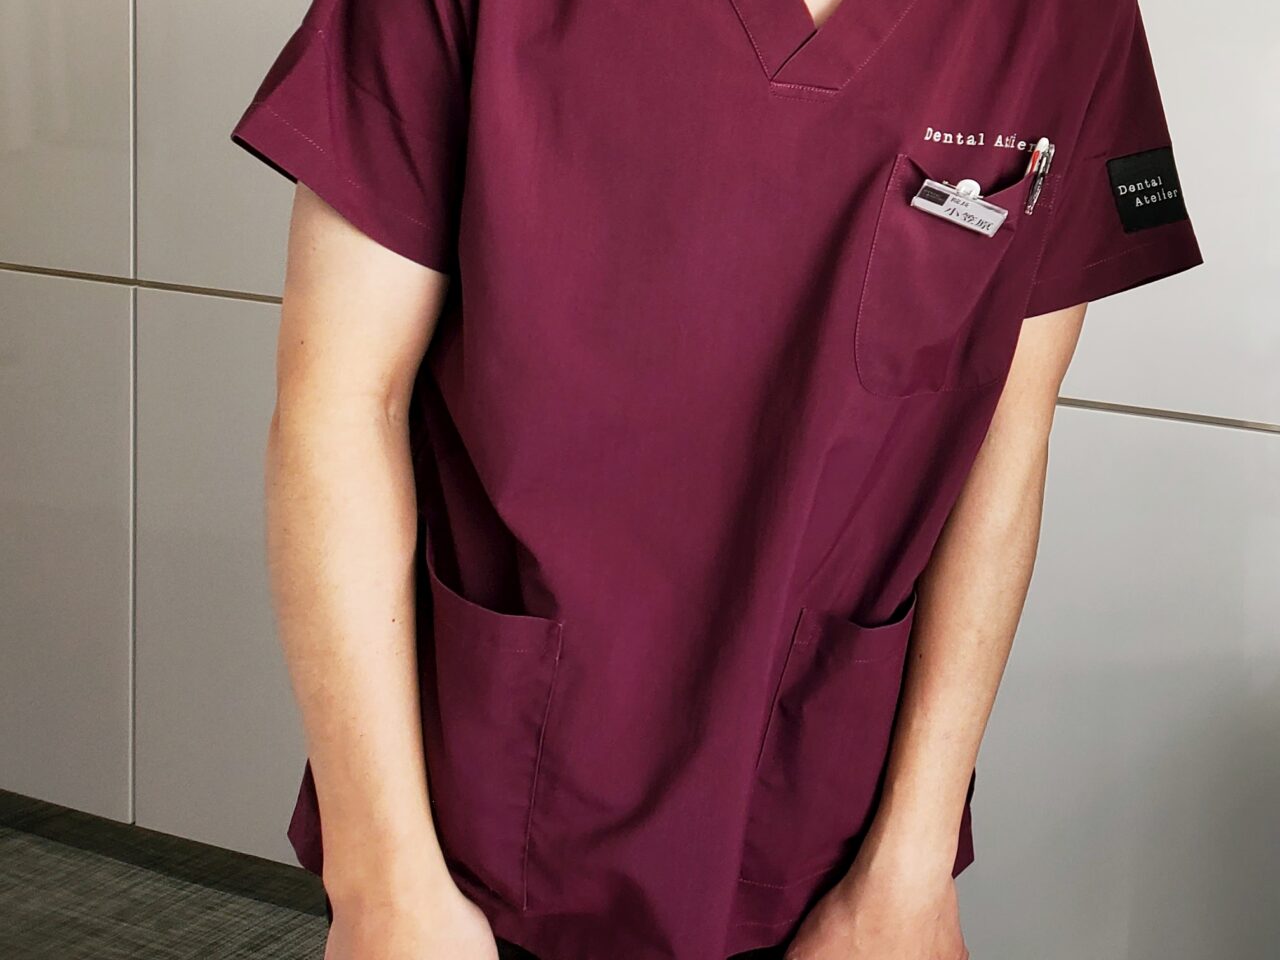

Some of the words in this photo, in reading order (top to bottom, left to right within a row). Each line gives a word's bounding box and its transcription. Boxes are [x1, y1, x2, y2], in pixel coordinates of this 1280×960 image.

[924, 126, 985, 146] Dental
[1118, 176, 1163, 196] Dental
[1135, 188, 1179, 208] Atelier
